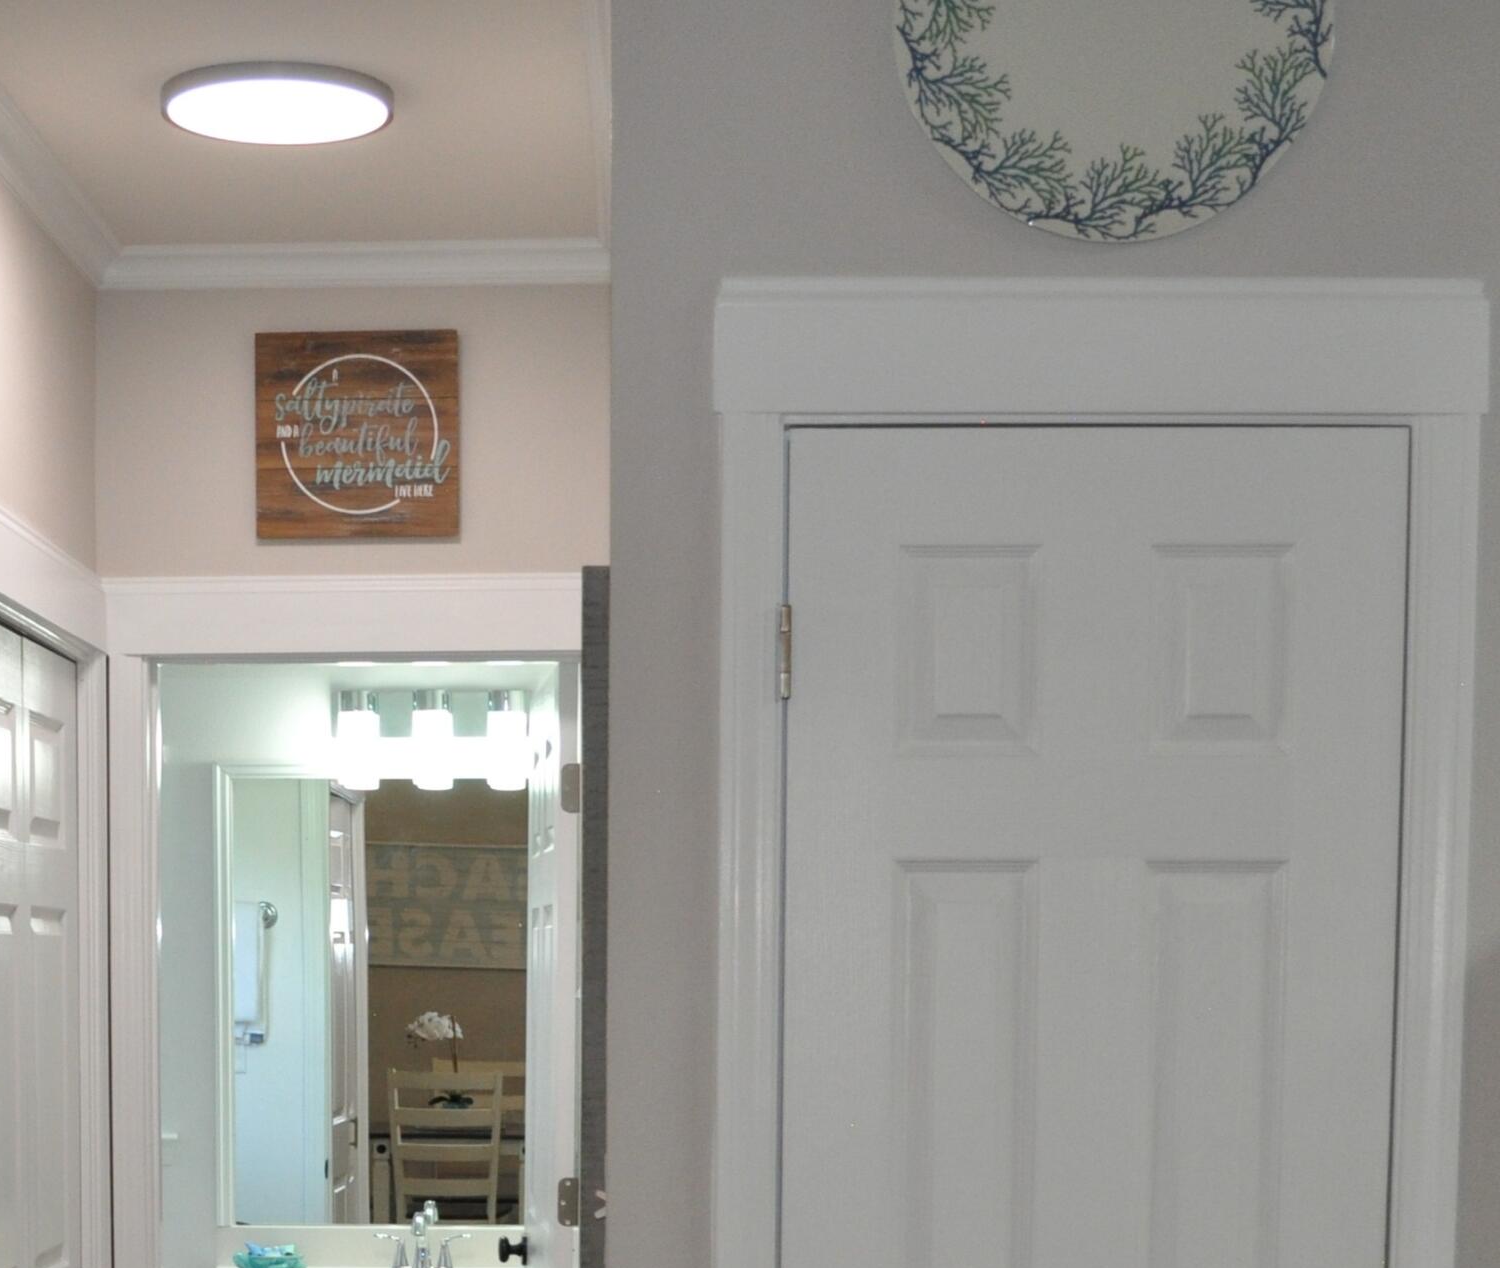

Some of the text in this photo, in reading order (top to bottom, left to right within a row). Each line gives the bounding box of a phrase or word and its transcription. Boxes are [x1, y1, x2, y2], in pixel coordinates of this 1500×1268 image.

[332, 368, 339, 383] A
[340, 382, 417, 428] pirate
[276, 417, 419, 464] AND A beautiful
[316, 439, 452, 490] mermaid
[395, 484, 434, 497] LIVE HERE
